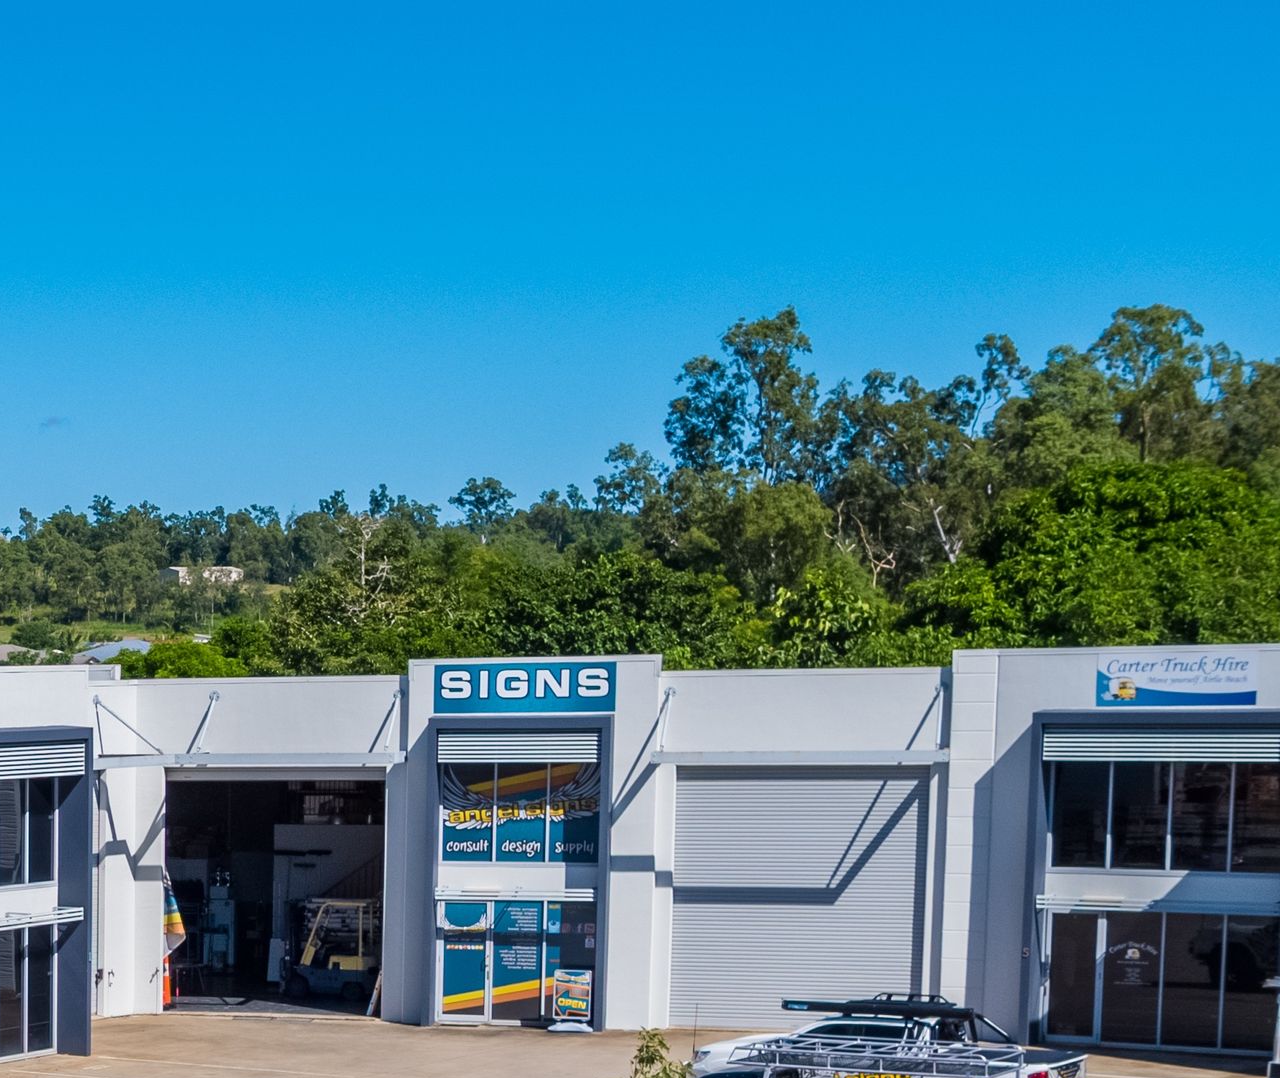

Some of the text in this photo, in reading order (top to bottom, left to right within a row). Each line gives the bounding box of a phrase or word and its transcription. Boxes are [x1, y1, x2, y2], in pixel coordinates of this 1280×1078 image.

[1106, 655, 1249, 674] Carter Truck Hire
[440, 667, 609, 699] SIGNS
[446, 839, 594, 857] consult design supply
[558, 997, 587, 1009] OPEN
